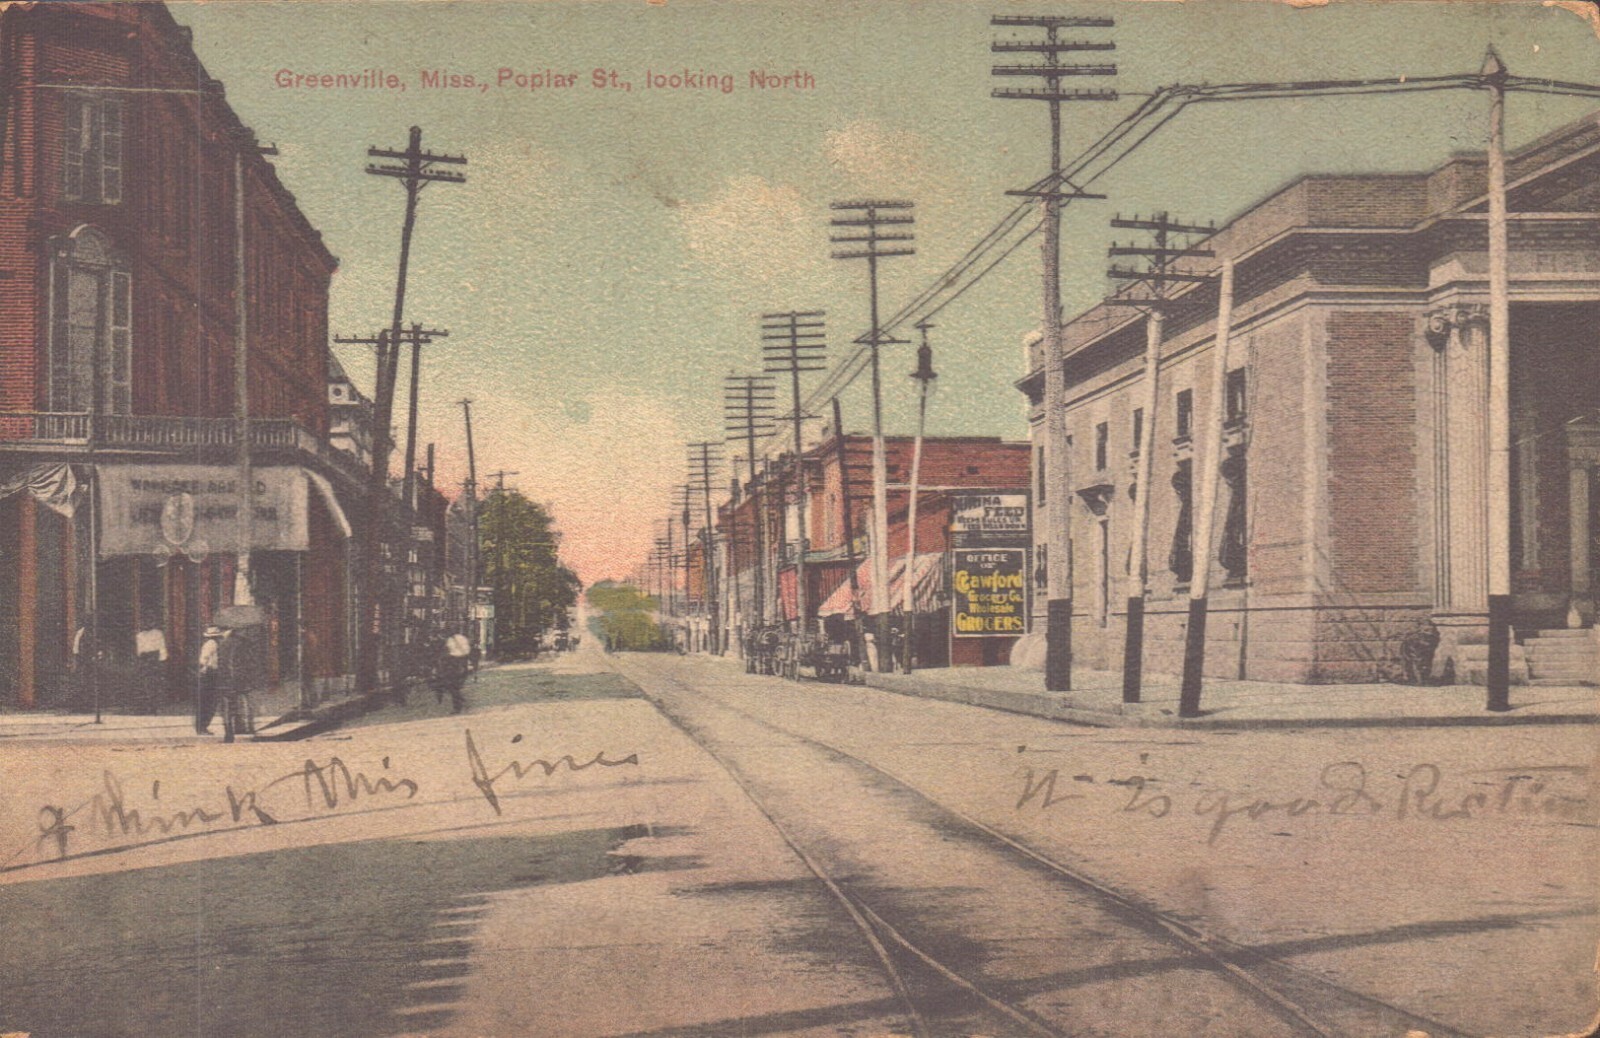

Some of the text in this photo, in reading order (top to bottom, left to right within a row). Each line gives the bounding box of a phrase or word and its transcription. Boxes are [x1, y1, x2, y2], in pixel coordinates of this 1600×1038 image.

[985, 507, 1024, 517] FEED
[966, 554, 1009, 562] OFFICE
[968, 590, 1008, 604] Grocery
[969, 603, 1015, 613] Wholesale
